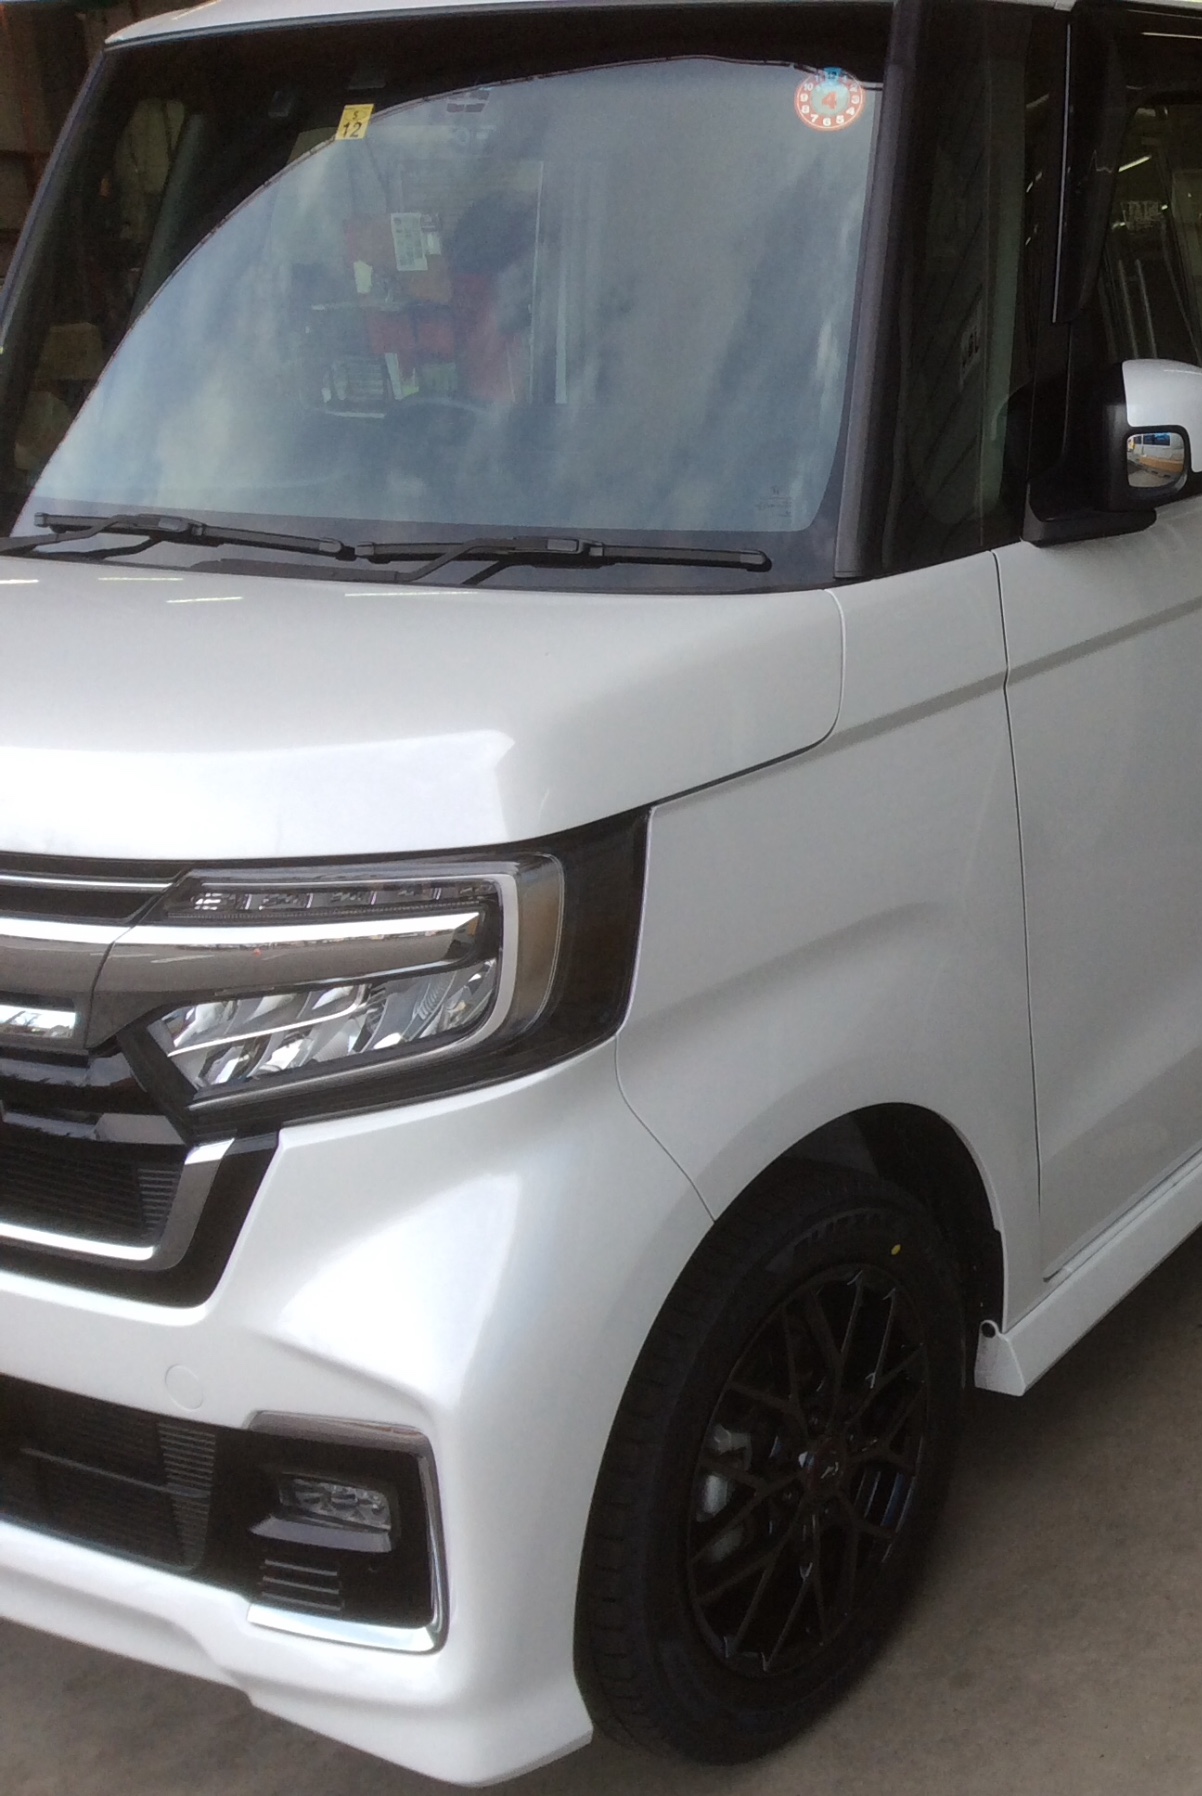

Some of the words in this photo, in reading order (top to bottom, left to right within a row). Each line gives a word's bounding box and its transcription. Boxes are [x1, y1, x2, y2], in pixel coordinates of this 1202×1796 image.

[804, 82, 814, 91] 10
[849, 83, 858, 92] 2
[800, 93, 809, 102] 9
[821, 91, 837, 110] 4
[851, 95, 860, 104] 3
[801, 105, 810, 114] 8
[845, 106, 855, 116] 4
[810, 114, 819, 123] 7
[823, 117, 831, 126] 6
[836, 115, 844, 124] 5
[343, 121, 362, 138] 12
